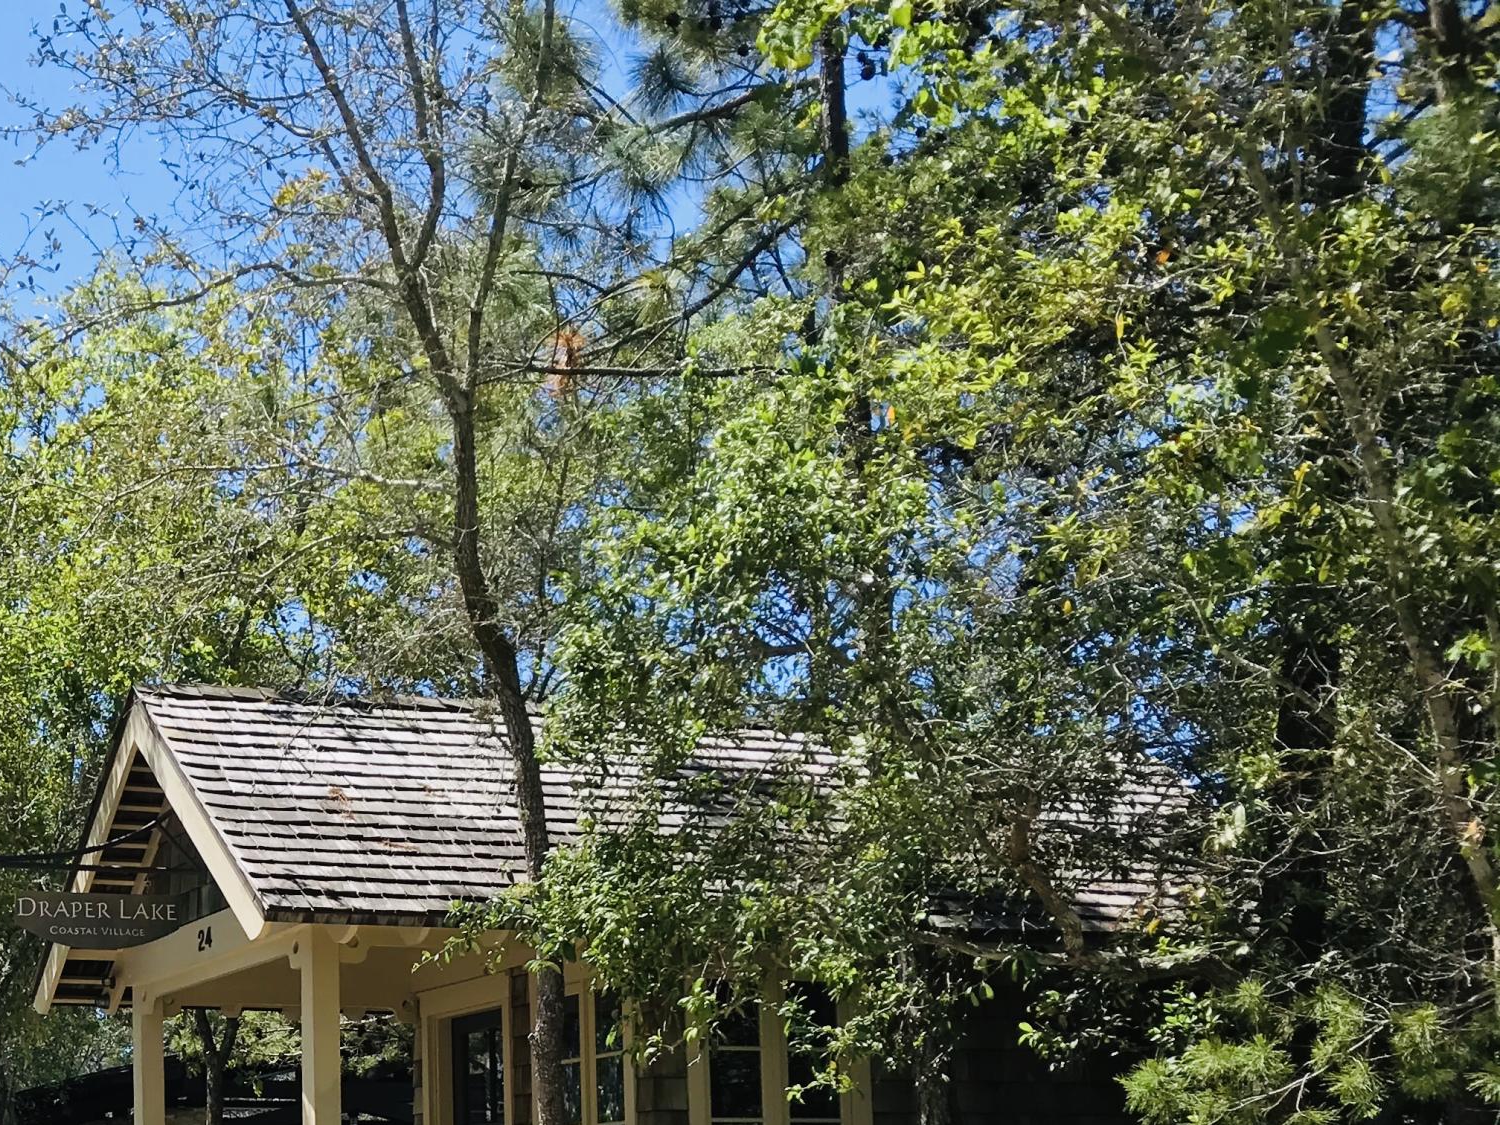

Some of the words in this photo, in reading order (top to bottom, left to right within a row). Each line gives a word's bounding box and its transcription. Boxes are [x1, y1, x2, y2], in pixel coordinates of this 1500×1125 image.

[17, 897, 111, 919] DRAPER
[120, 899, 178, 921] LAKE
[49, 925, 98, 936] COASTAL
[101, 927, 147, 937] VILLAGE
[197, 926, 213, 952] 24
